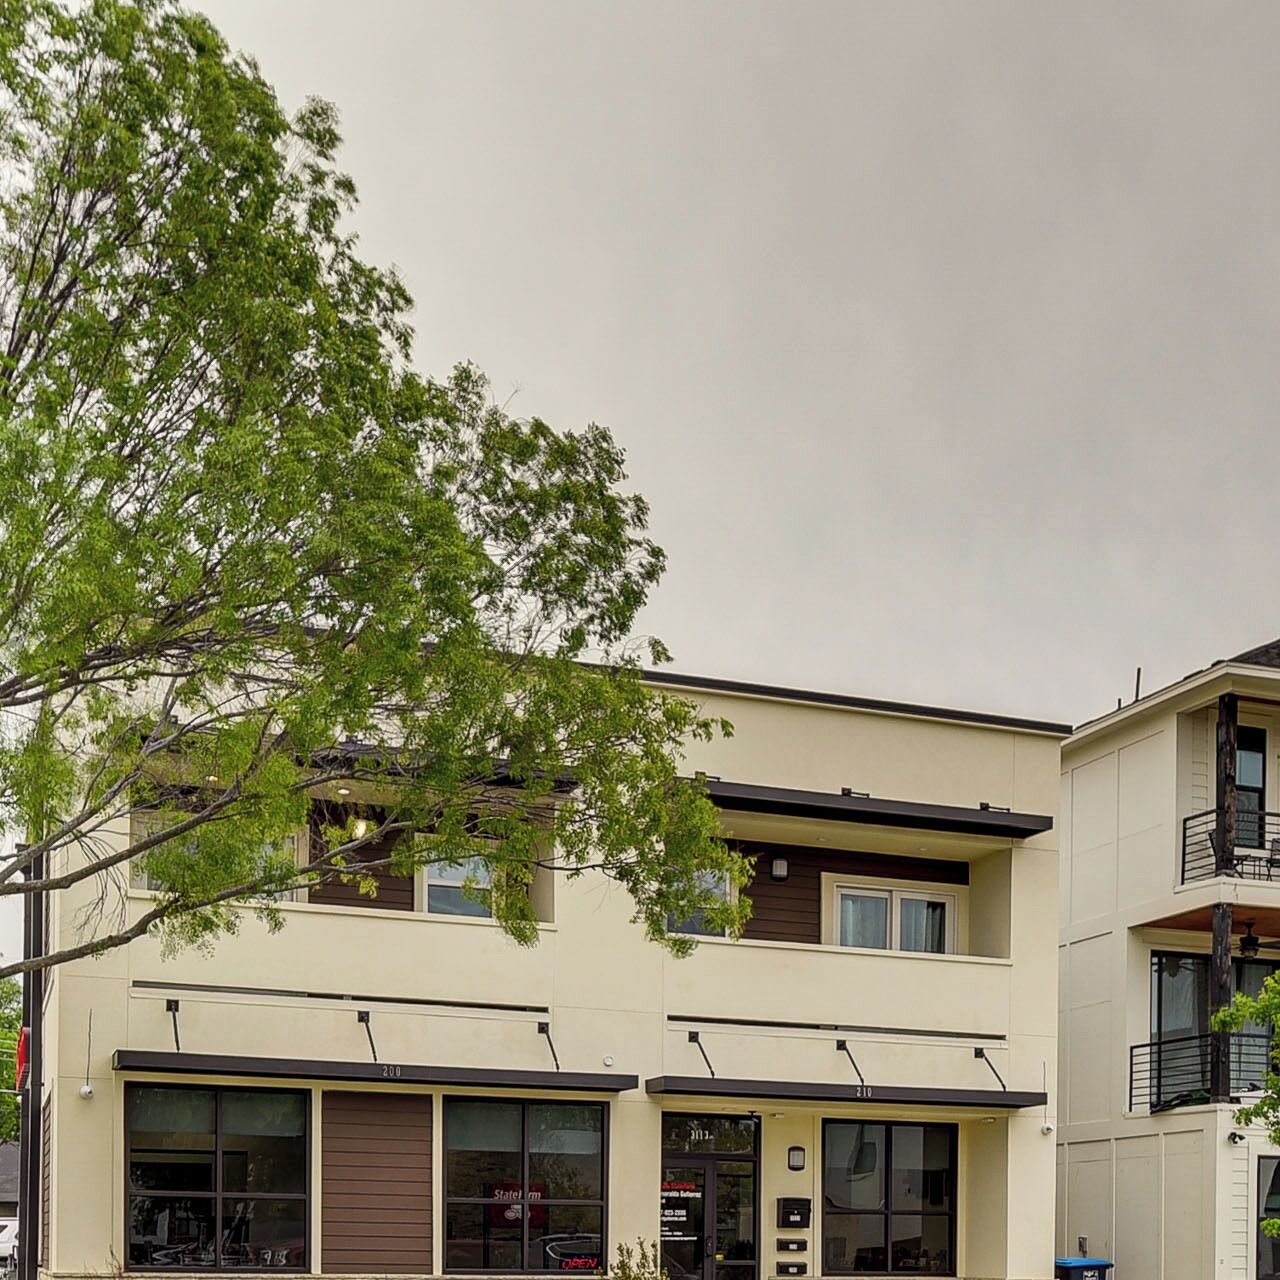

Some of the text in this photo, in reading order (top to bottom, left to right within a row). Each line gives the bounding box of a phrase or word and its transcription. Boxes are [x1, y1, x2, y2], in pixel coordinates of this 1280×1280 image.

[382, 1065, 401, 1077] 200
[856, 1087, 872, 1097] 210
[493, 1189, 542, 1200] Staterm
[561, 1258, 598, 1271] OPEN
